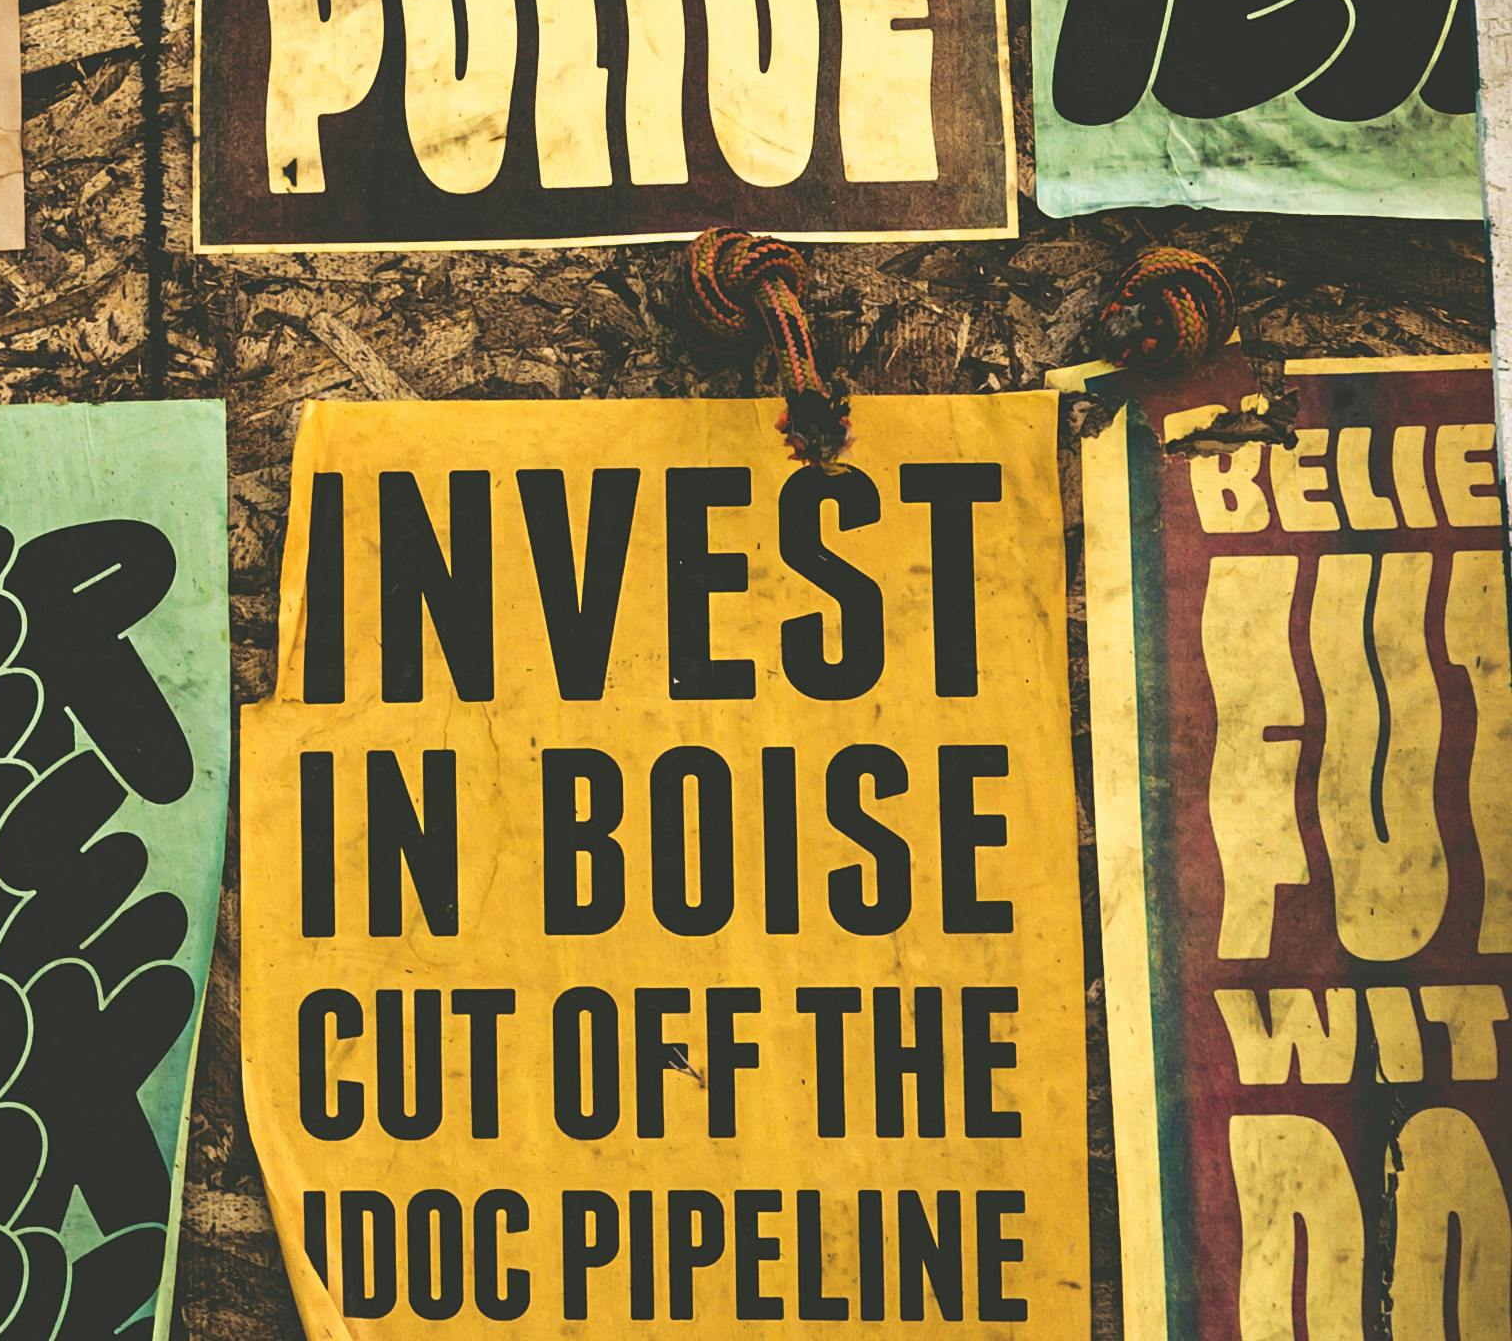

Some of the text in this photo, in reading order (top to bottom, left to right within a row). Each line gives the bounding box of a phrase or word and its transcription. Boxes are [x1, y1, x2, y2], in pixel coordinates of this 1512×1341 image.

[302, 462, 1004, 705] INVEST
[300, 744, 1013, 937] IN BOISE
[299, 987, 1021, 1141] CUT OFF THE
[303, 1188, 531, 1321] IDOC
[562, 1188, 1028, 1323] PIPELINE
